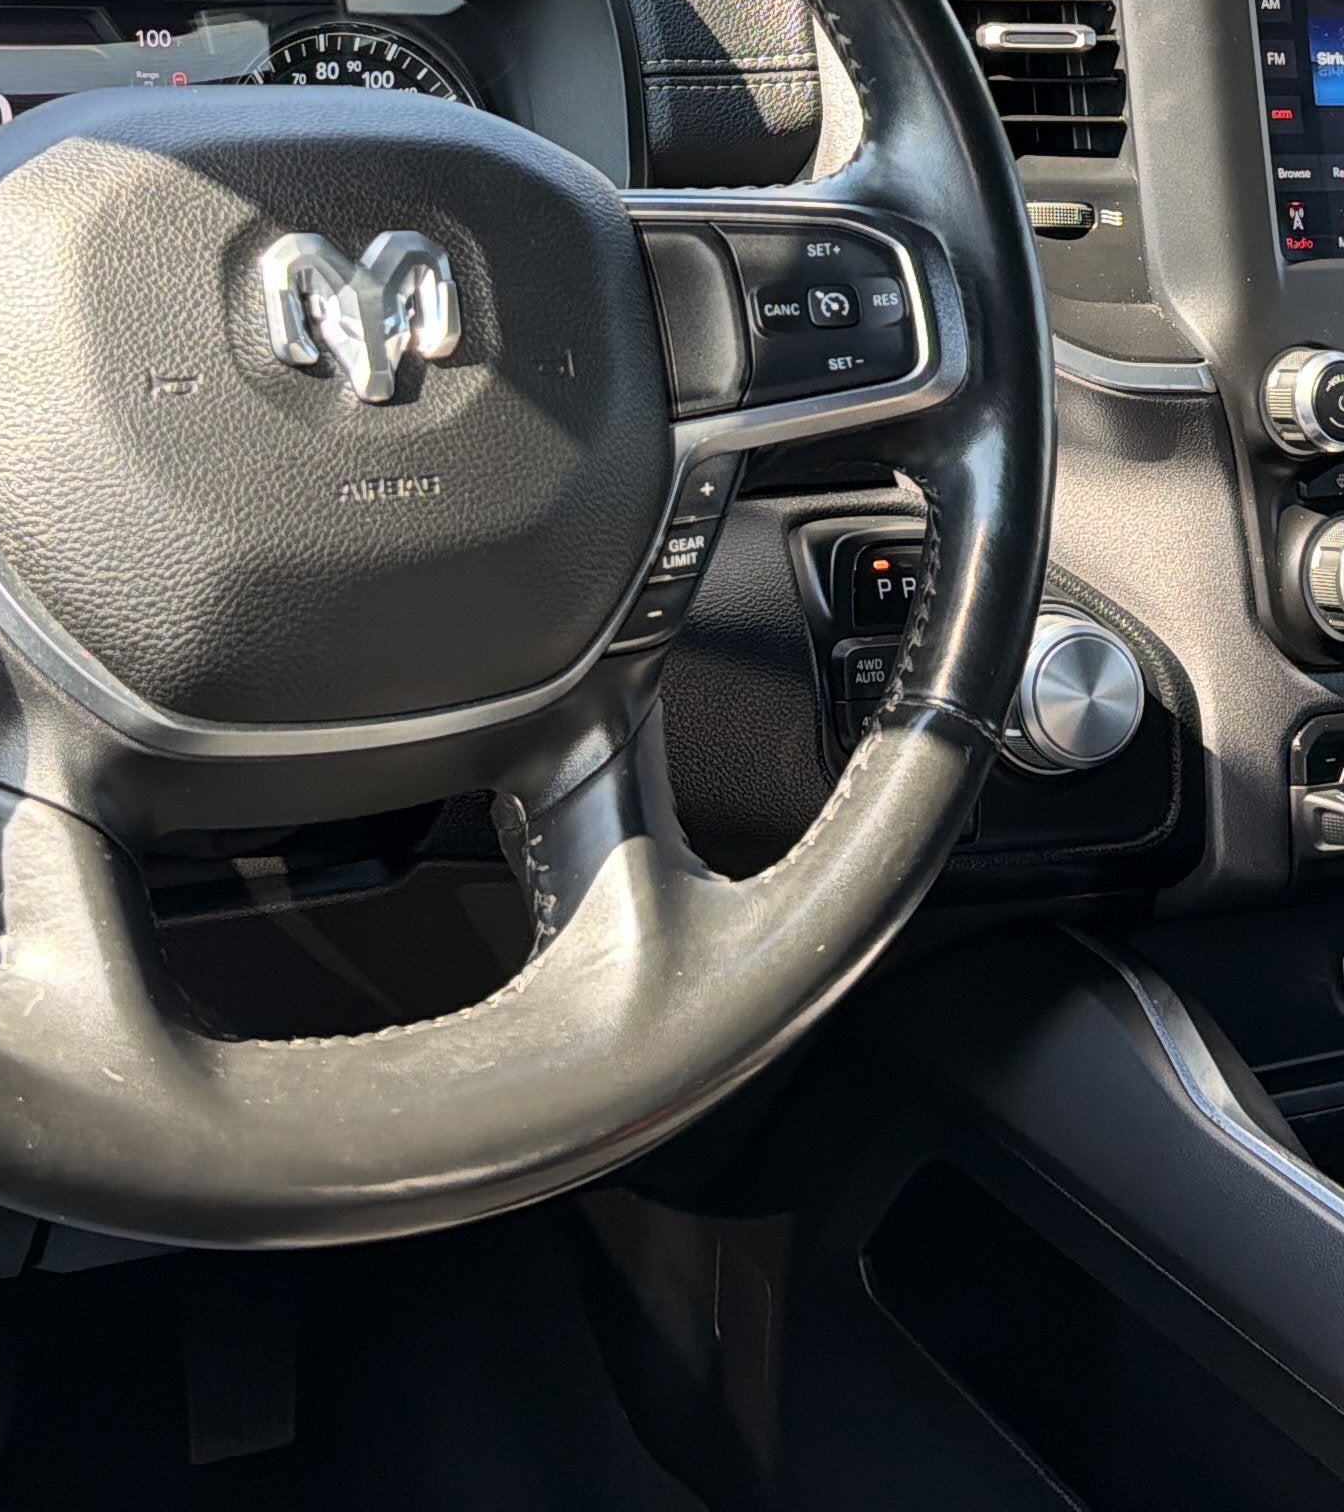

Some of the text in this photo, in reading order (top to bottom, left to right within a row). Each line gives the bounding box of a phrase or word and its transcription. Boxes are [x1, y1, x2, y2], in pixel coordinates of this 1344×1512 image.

[134, 28, 173, 49] 100
[1266, 51, 1286, 66] FM
[315, 61, 340, 80] 80
[346, 60, 363, 73] 90
[291, 72, 307, 86] 70
[361, 70, 395, 89] 100
[1277, 167, 1312, 180] Browse
[1285, 237, 1315, 250] Radio
[872, 292, 899, 307] RES
[763, 302, 801, 318] CANC
[668, 535, 705, 553] GEAR
[662, 551, 699, 569] LIMIT
[876, 578, 892, 600] P
[856, 658, 884, 671] 4WD
[855, 670, 886, 684] AUTO
